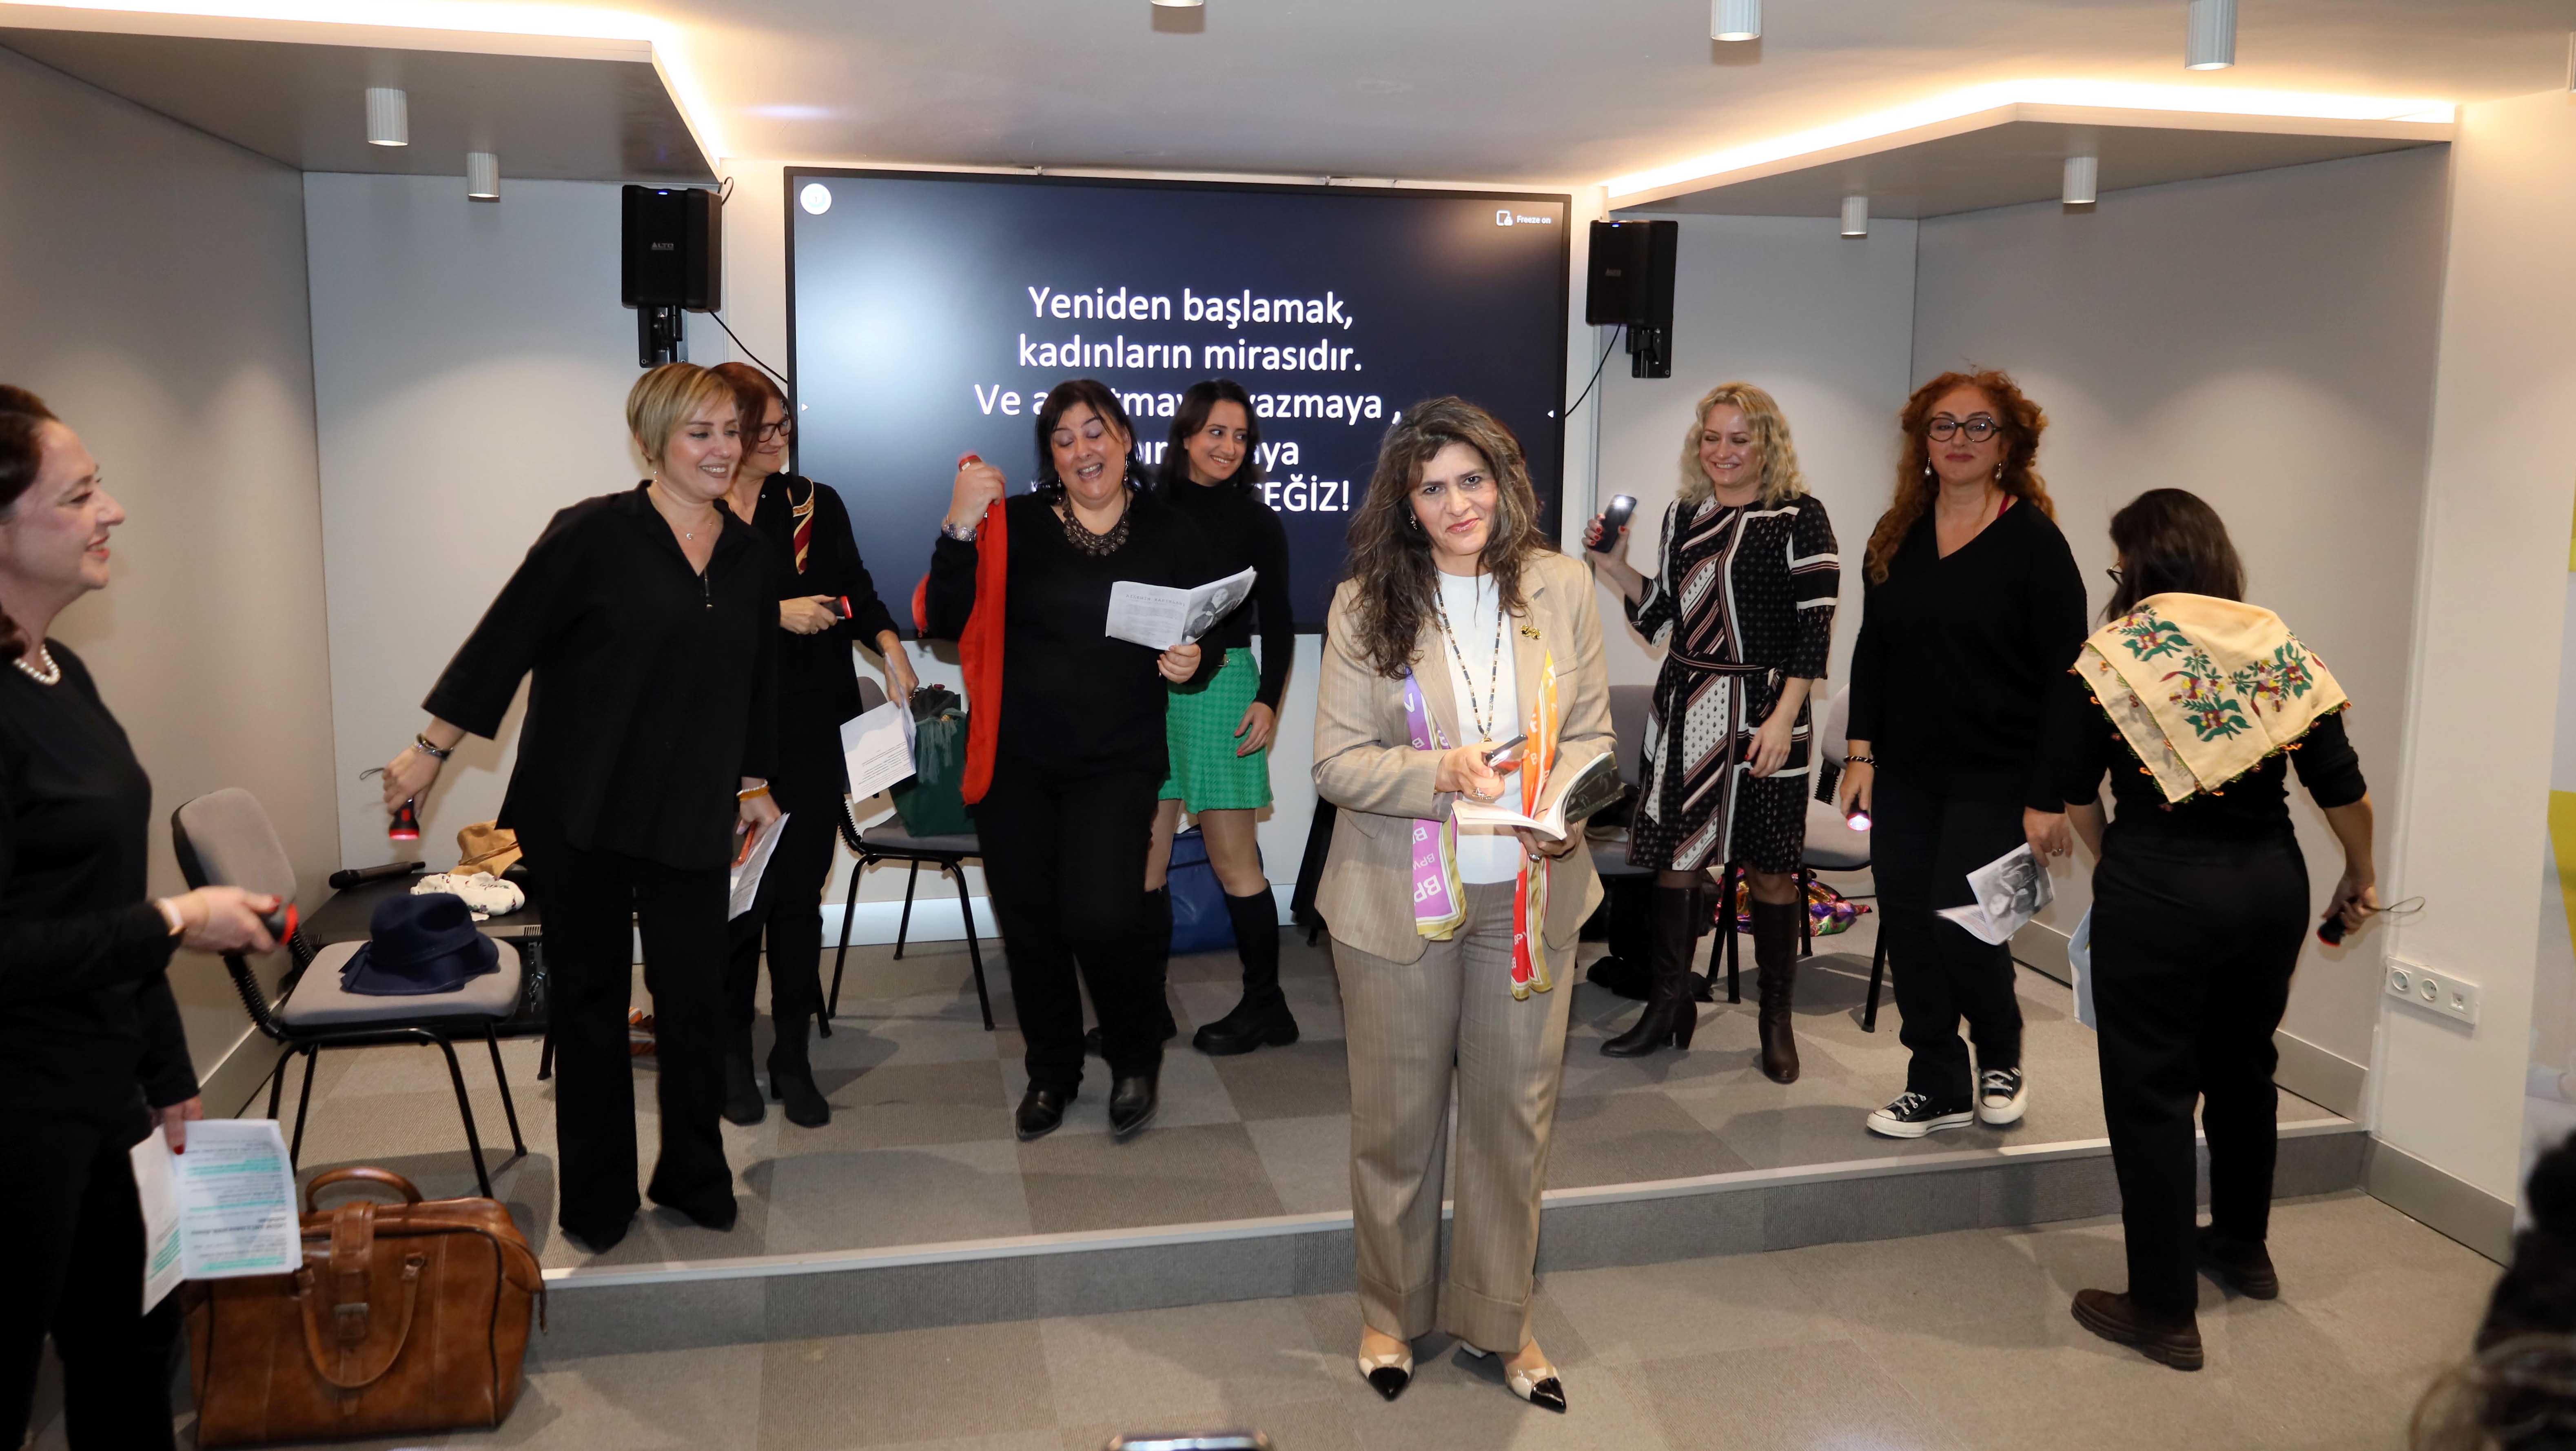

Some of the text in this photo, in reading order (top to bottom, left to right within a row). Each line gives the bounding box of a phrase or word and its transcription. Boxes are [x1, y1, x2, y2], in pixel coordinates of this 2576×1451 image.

[1516, 215, 1540, 224] Freeze
[1028, 286, 1353, 330] Yeniden başlamak,
[1020, 333, 1362, 371] kadınların mirasıdır.
[974, 384, 1021, 415] Ve
[1414, 874, 1442, 906] BP
